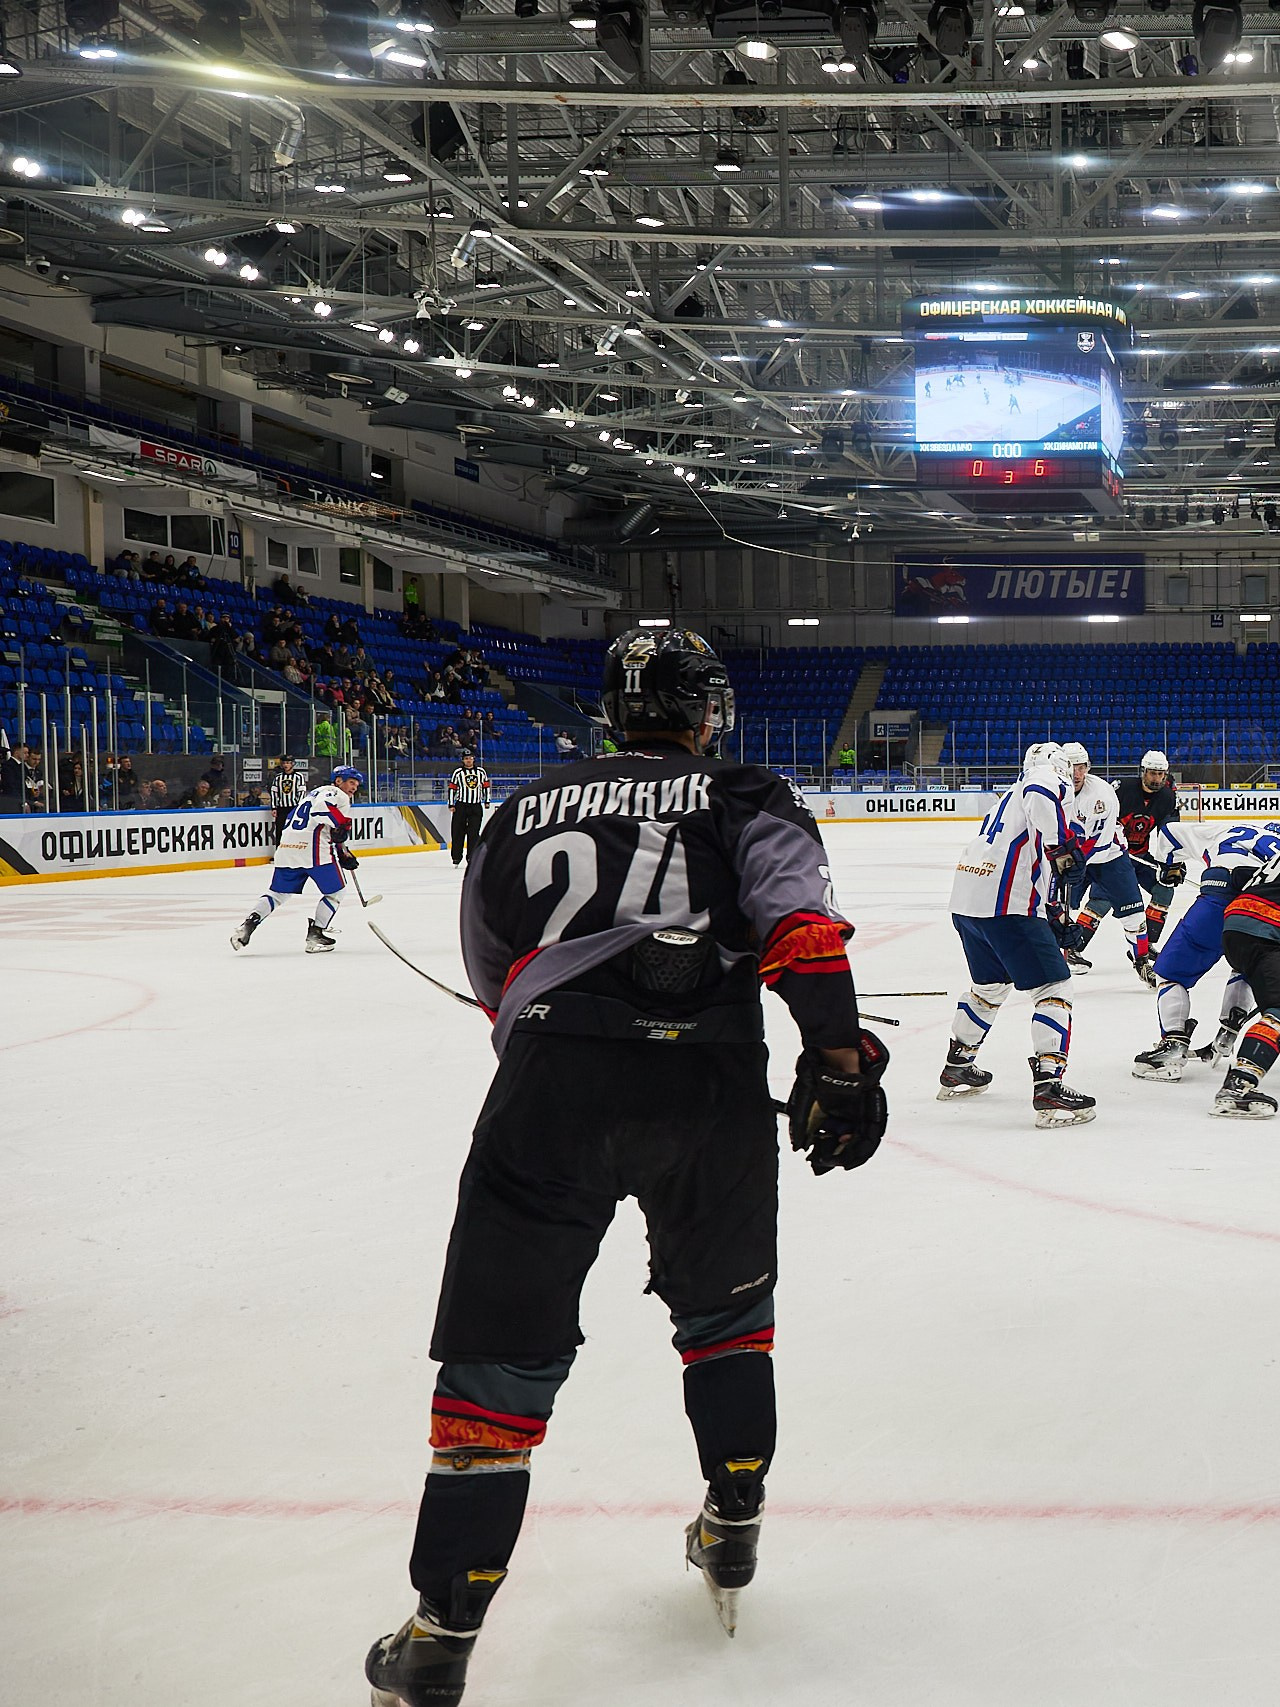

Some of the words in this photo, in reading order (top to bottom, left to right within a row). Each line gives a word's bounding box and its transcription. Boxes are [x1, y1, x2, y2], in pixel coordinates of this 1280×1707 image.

[920, 300, 1020, 318] ОФИЦЕРСКАЯ
[1025, 296, 1113, 318] ХОККЕЙНАЯ
[992, 443, 1022, 458] 0:00
[154, 449, 203, 473] SPAR
[973, 460, 983, 477] 0
[1034, 460, 1044, 476] 6
[1004, 471, 1013, 484] 3
[230, 534, 239, 548] 10
[986, 568, 1131, 600] ЛЮТЫЕ!
[624, 670, 642, 693] 11
[514, 773, 714, 838] СУРАЙКИН
[866, 797, 956, 813] OHLIGA.RU
[1180, 793, 1279, 811] ХОККЕЙНАЯ
[41, 824, 214, 862] ОФИЦЕРСКАЯ
[525, 820, 711, 949] 24
[820, 1074, 860, 1088] CCM
